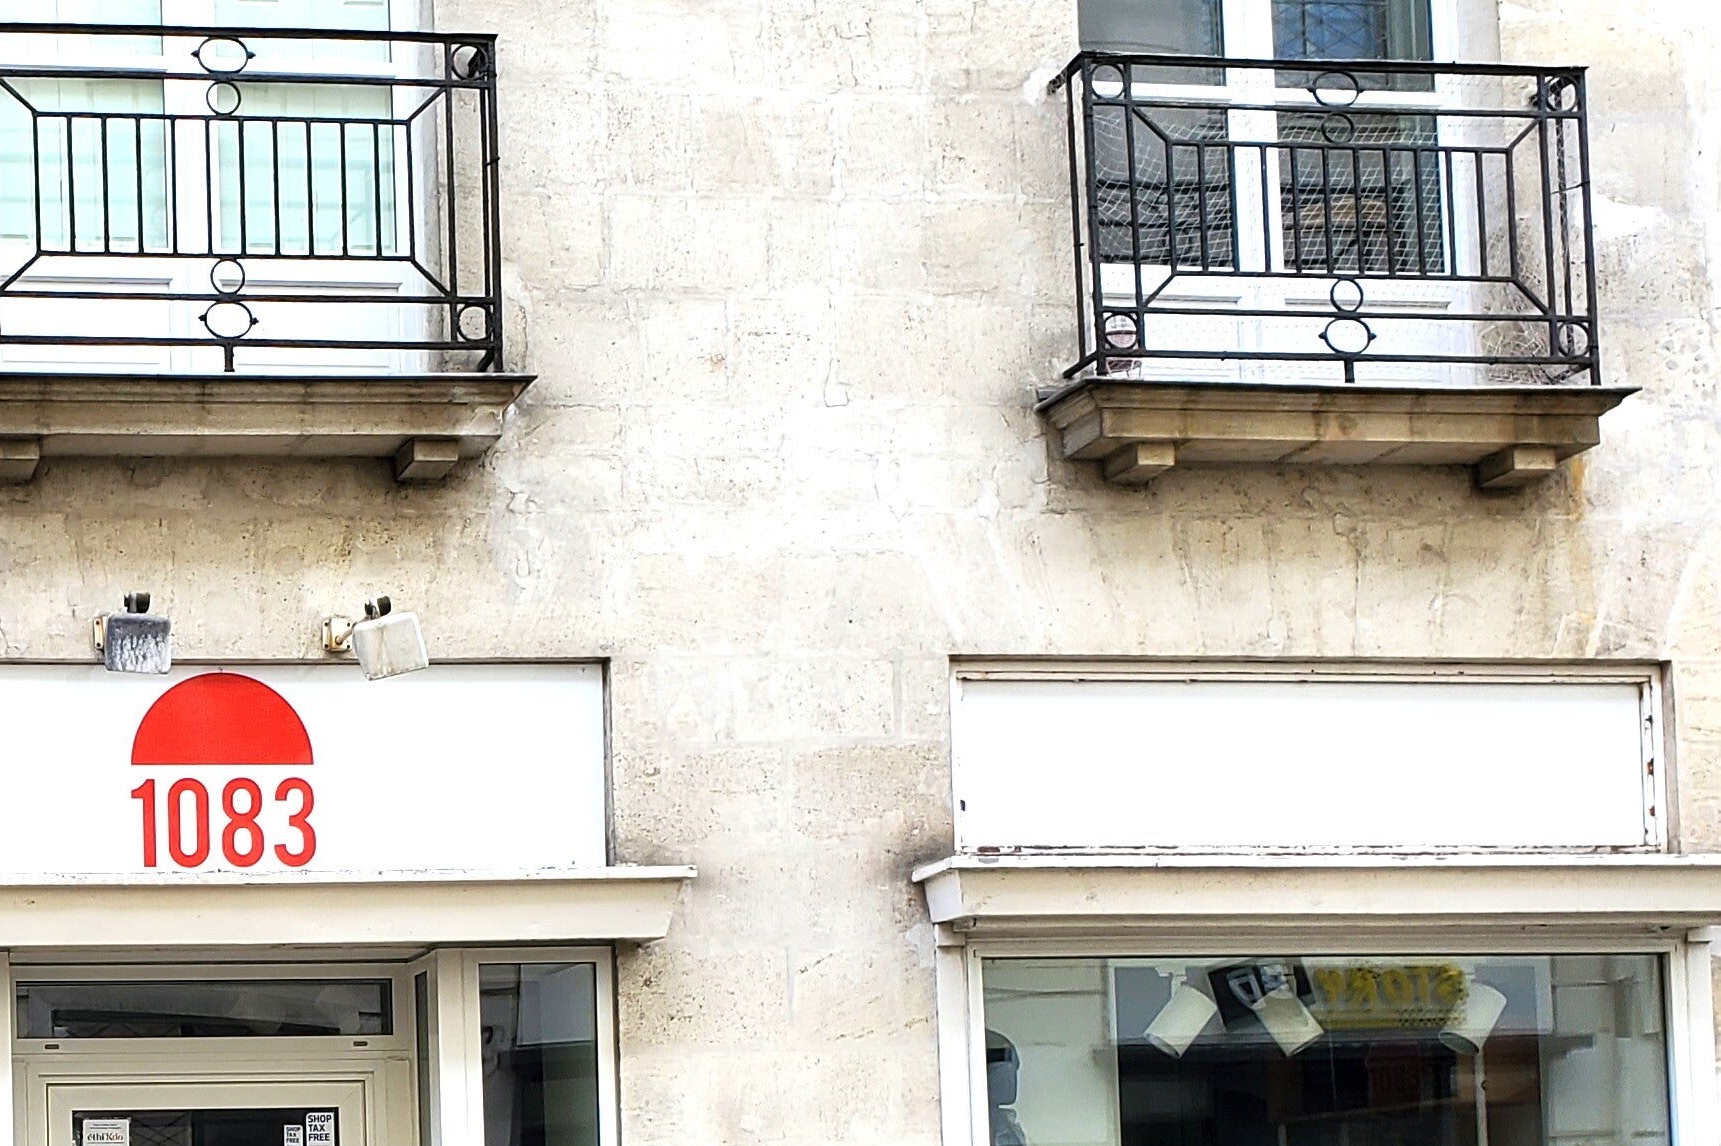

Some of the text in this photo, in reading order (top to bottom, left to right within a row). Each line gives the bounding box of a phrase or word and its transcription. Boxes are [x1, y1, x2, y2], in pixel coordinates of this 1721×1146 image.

[130, 776, 317, 868] 1083
[307, 1114, 332, 1123] SHOP
[308, 1123, 326, 1132] TAX
[308, 1133, 331, 1142] FREE
